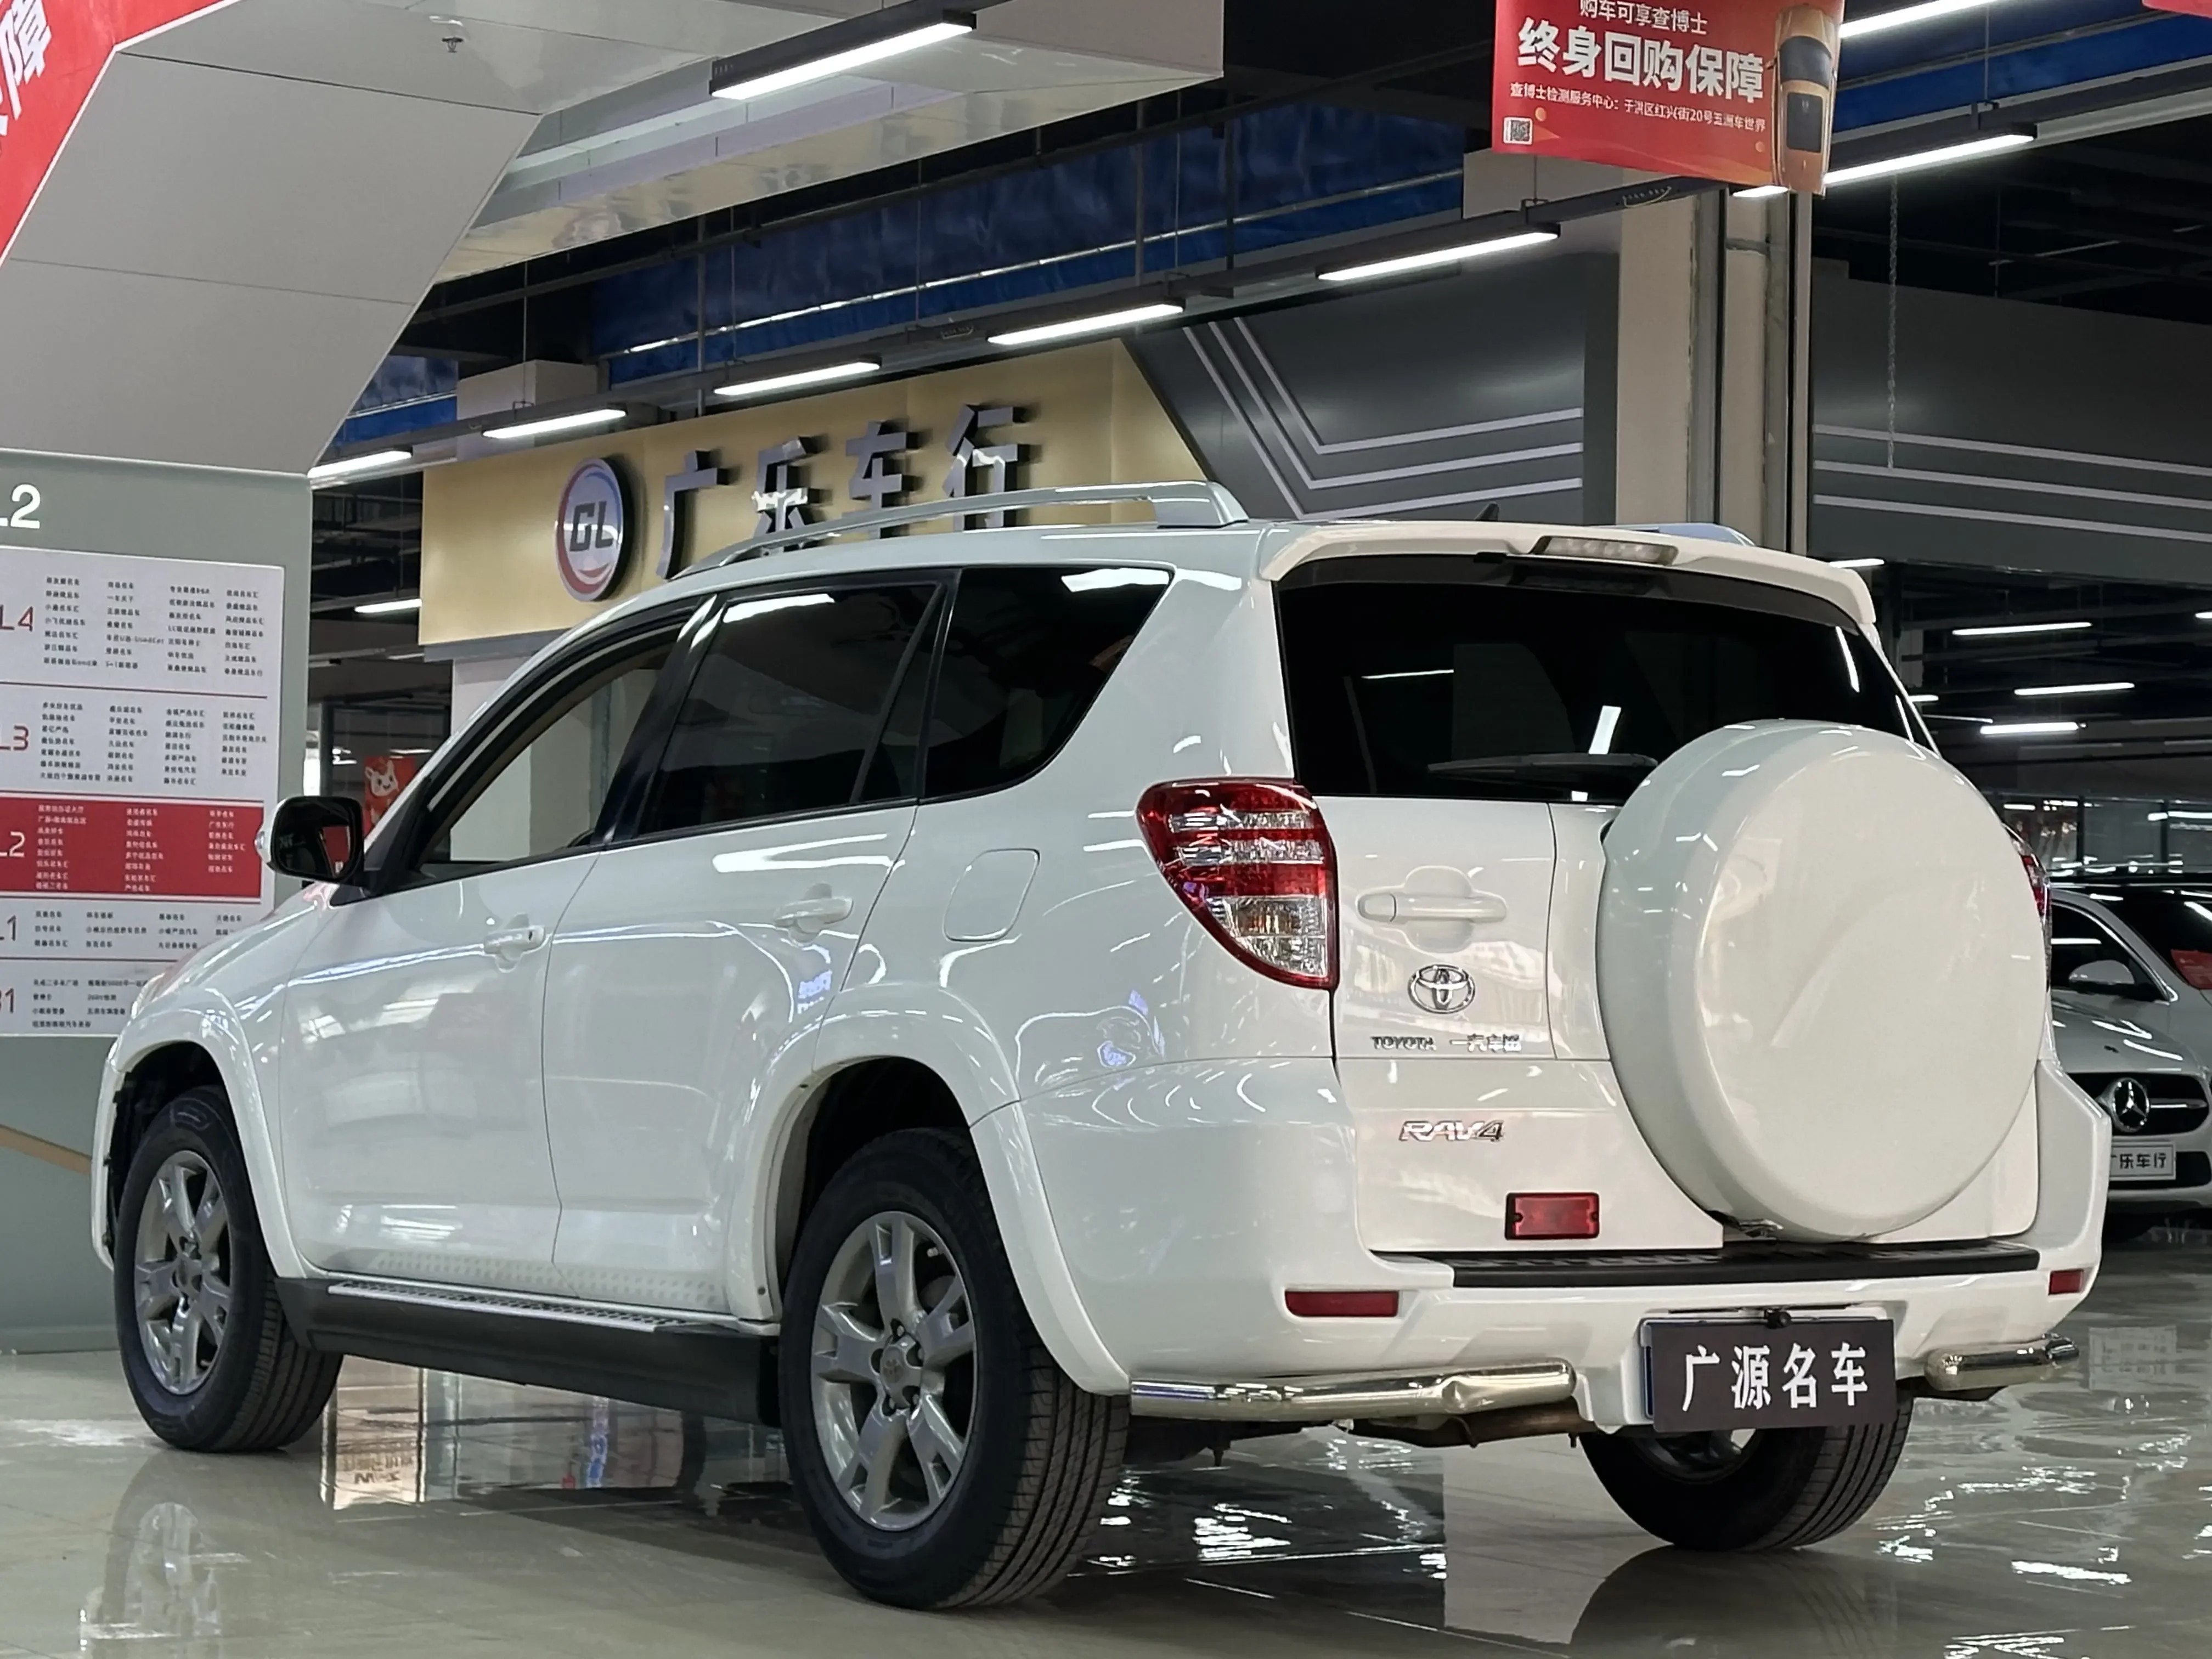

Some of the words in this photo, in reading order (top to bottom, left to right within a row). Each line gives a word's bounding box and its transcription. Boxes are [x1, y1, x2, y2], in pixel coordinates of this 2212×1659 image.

[1580, 0, 1707, 35] 购车可享查博士
[1517, 17, 1765, 104] 终身回购保障
[0, 484, 41, 529] 2
[656, 404, 1026, 579] 广乐车行
[1372, 1036, 1436, 1051] TOYOTA
[1399, 1120, 1504, 1142] RAV4
[2111, 1153, 2166, 1169] 乐车行
[1682, 1342, 1869, 1412] 广源名车
